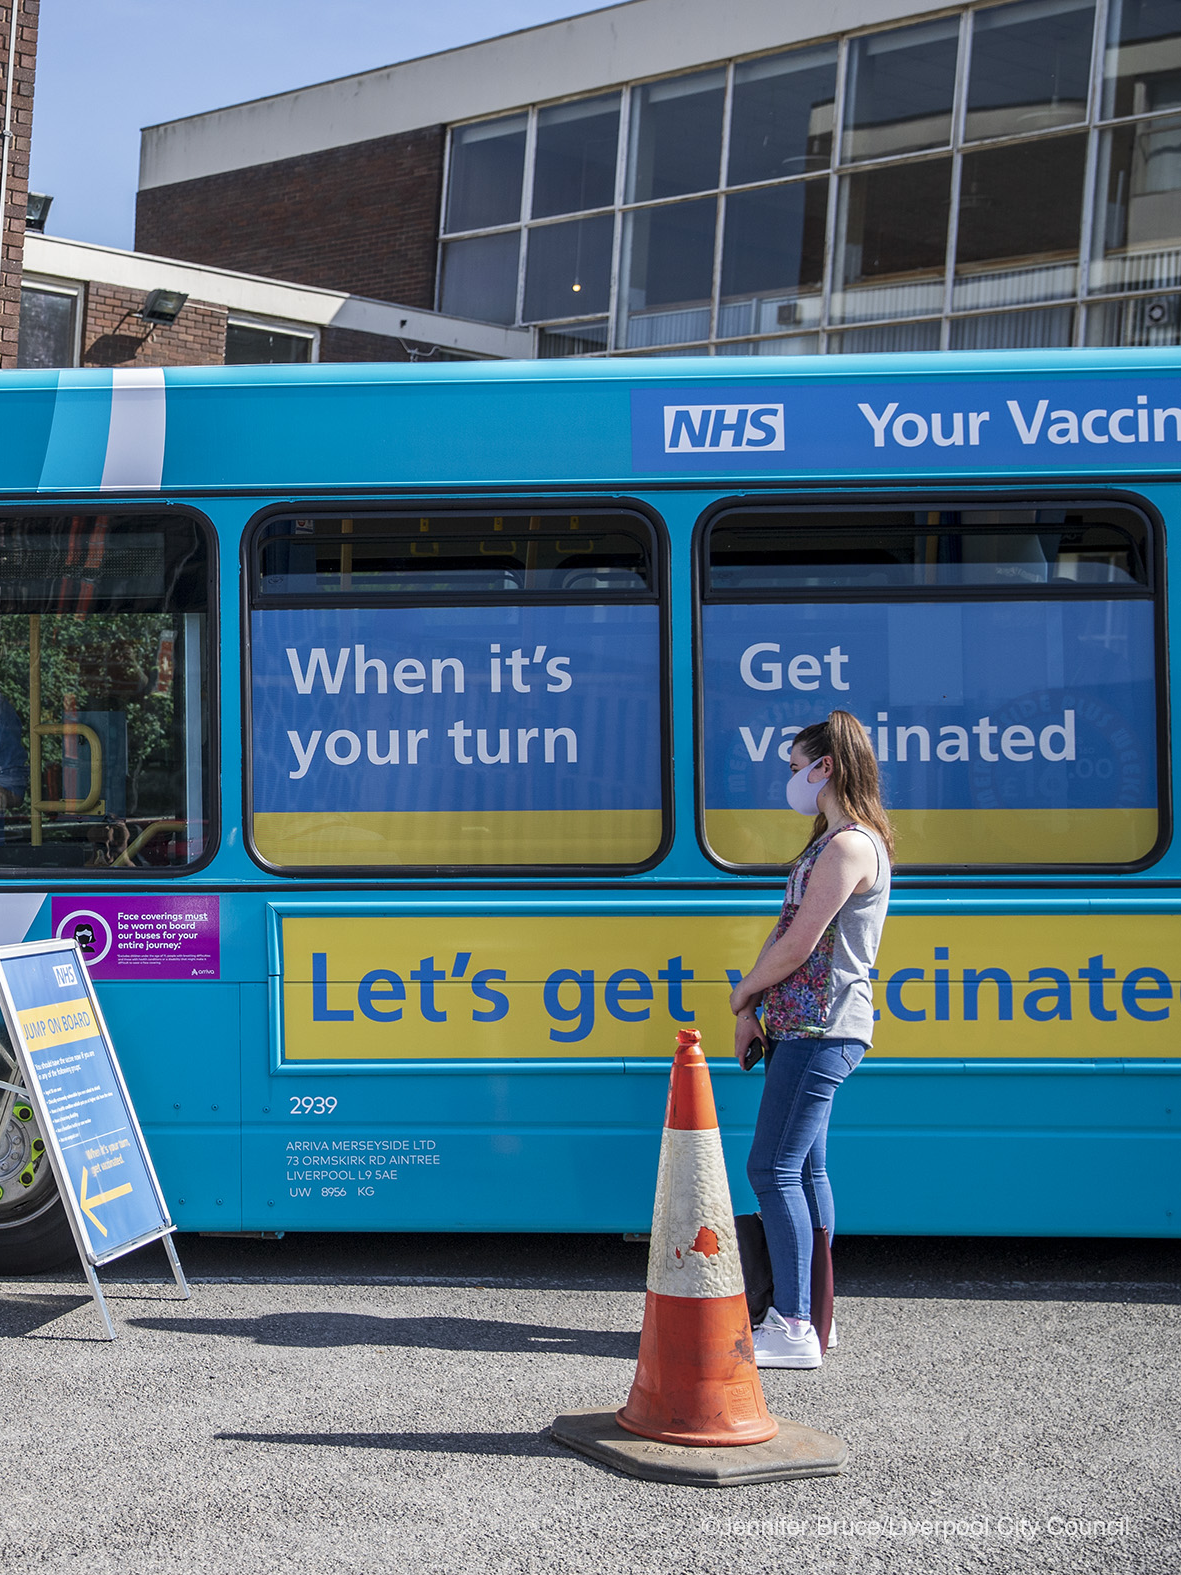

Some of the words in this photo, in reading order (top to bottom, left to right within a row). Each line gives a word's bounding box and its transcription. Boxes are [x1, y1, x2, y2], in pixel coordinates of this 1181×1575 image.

[668, 407, 781, 450] NHS
[858, 402, 990, 448] Your
[1006, 395, 1181, 445] Vaccin
[285, 644, 465, 695] When
[490, 643, 573, 694] it's
[739, 642, 850, 691] Get
[739, 709, 1076, 763] vainated
[287, 730, 429, 780] your
[447, 720, 578, 765] turn
[117, 912, 139, 920] Face
[141, 912, 182, 921] coverings
[184, 912, 208, 921] must
[117, 922, 129, 930] be
[169, 922, 196, 930] board
[117, 932, 133, 940] our
[135, 931, 160, 940] buses
[162, 931, 176, 939] for
[178, 932, 198, 941] your
[117, 941, 144, 949] entire
[55, 967, 76, 985] NHS
[311, 951, 510, 1023] Let's
[542, 955, 696, 1043] get
[725, 946, 1181, 1022] cinate
[23, 1020, 47, 1041] JUMP
[47, 1017, 62, 1035] ON
[61, 1011, 91, 1032] BOARD
[289, 1096, 338, 1115] 2939
[85, 1147, 100, 1161] When
[99, 1144, 109, 1155] it's
[108, 1142, 118, 1156] your
[285, 1141, 330, 1151] ARRIVA
[332, 1140, 410, 1151] MERSEYSIDE
[413, 1140, 436, 1150] LTD
[286, 1156, 300, 1166] 73
[302, 1155, 366, 1166] ORMSKIRK
[369, 1155, 386, 1165] RD
[388, 1154, 441, 1165] AINTREE
[90, 1163, 101, 1177] get
[286, 1170, 356, 1181] LIVERPOOL
[358, 1170, 372, 1180] L9
[375, 1169, 398, 1180] 5AE
[289, 1187, 312, 1198] UW
[321, 1187, 347, 1197] 8956
[357, 1186, 375, 1197] KG
